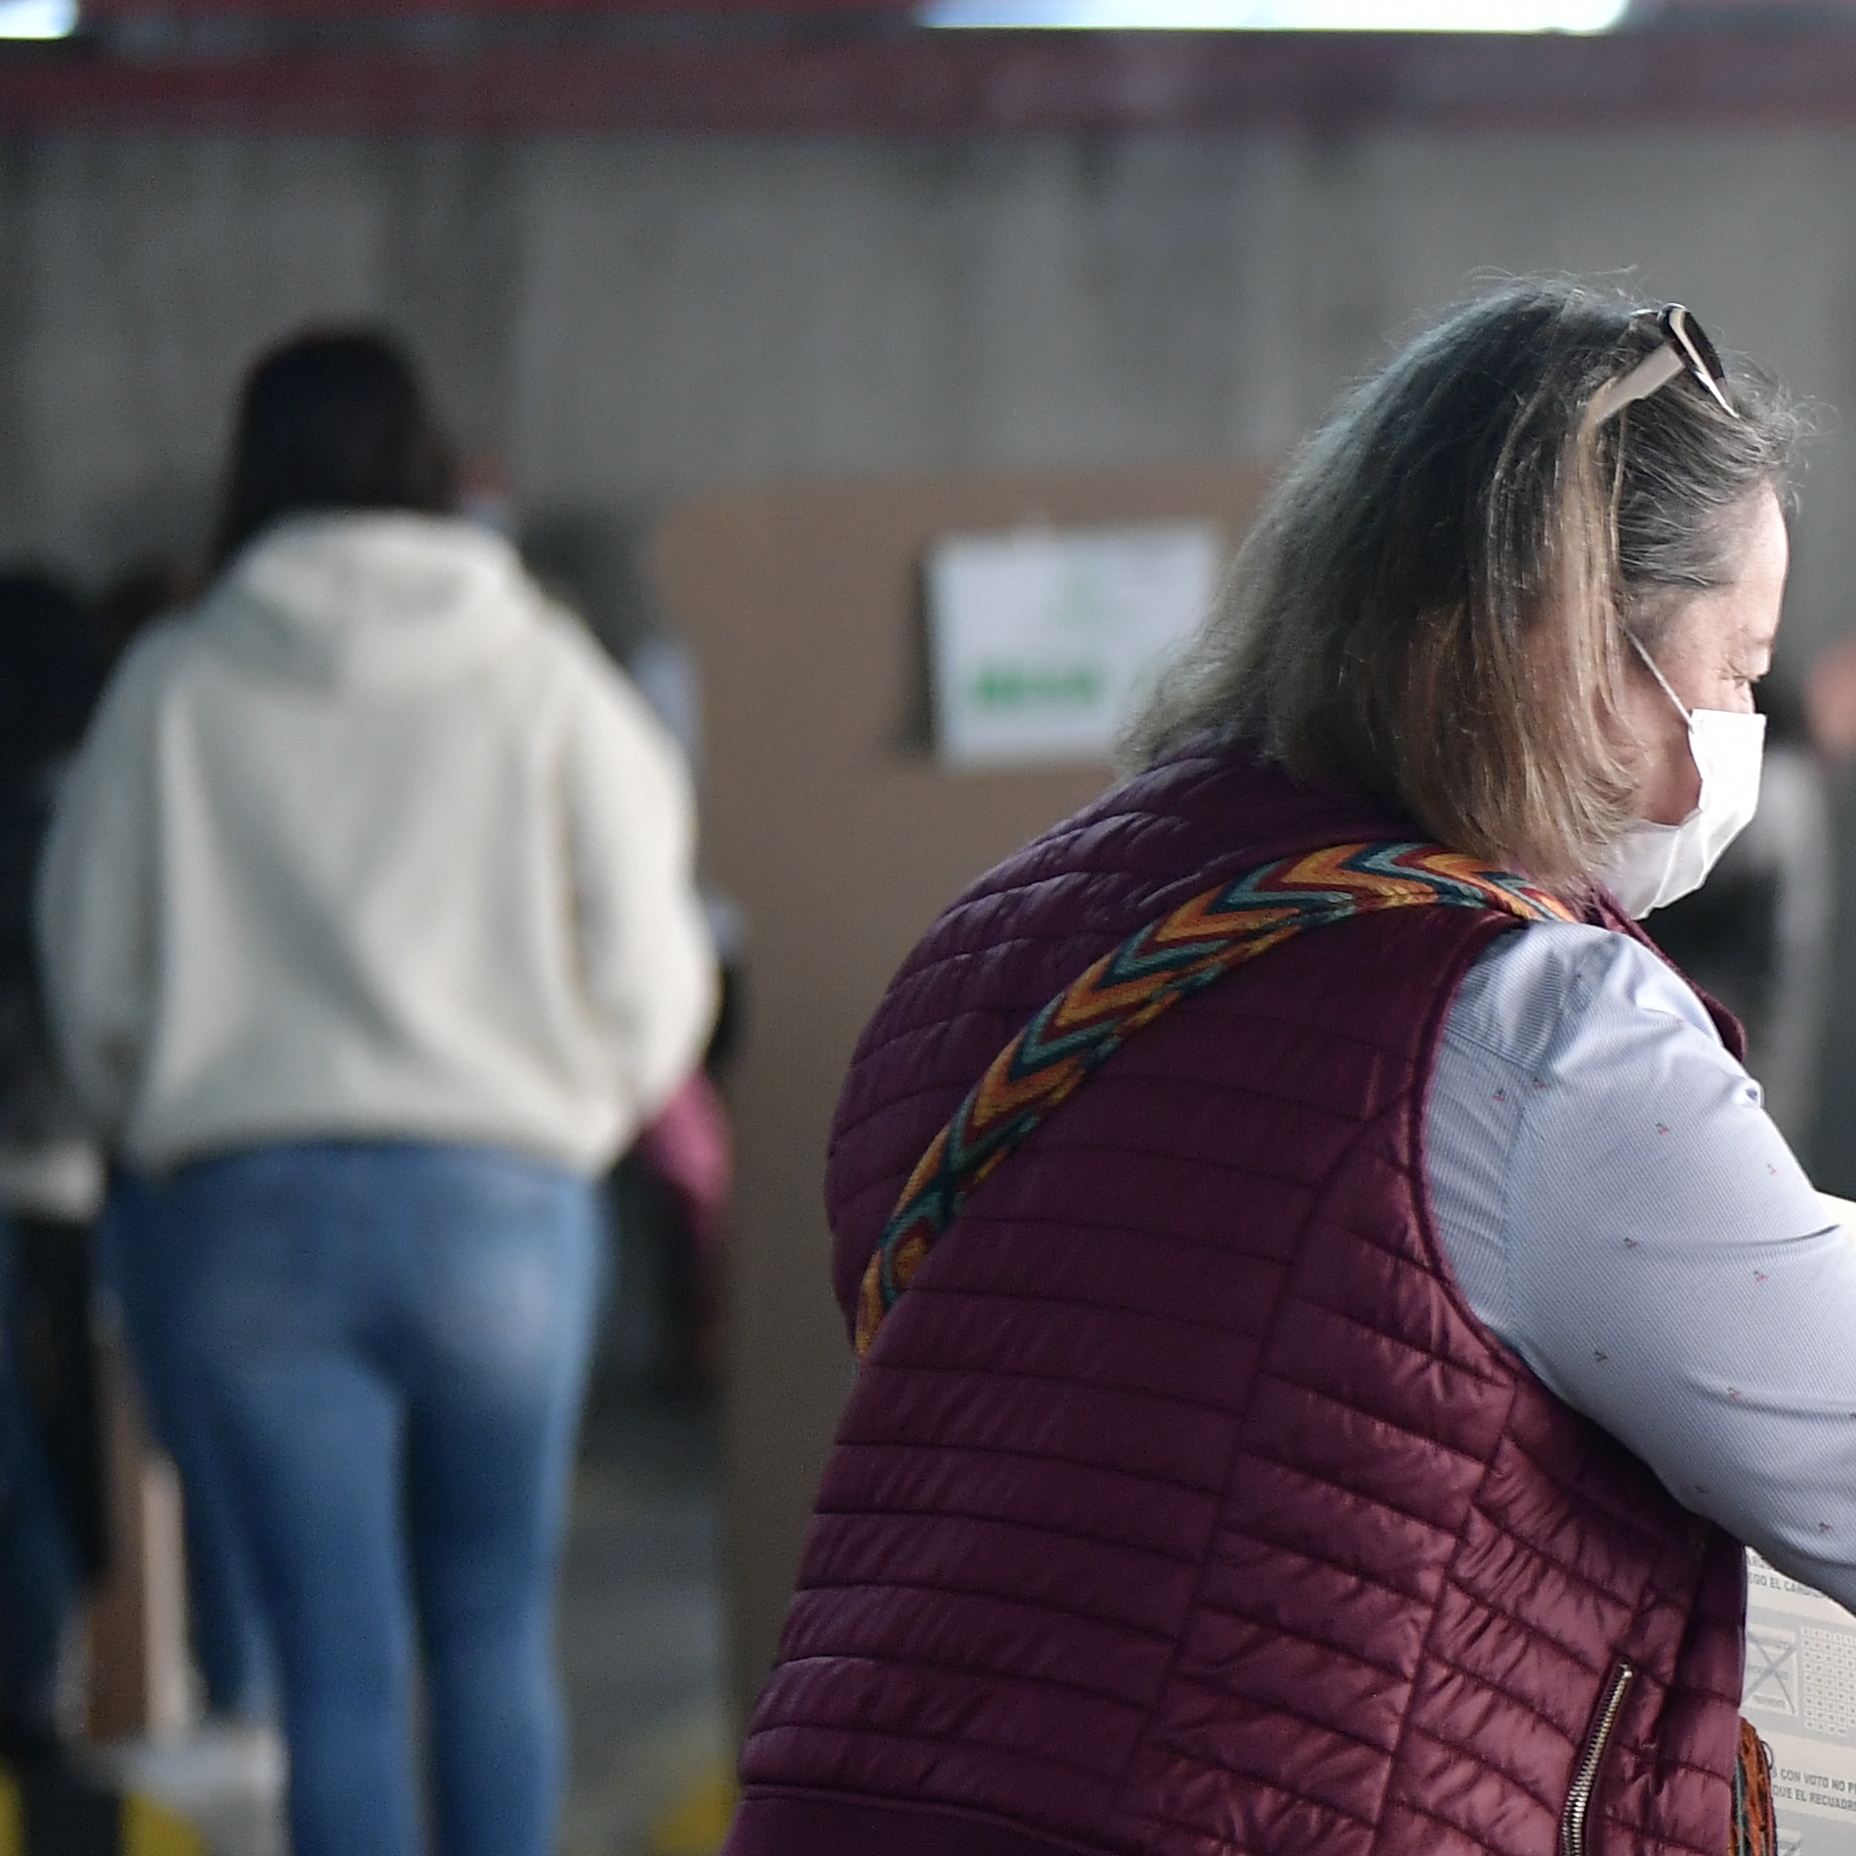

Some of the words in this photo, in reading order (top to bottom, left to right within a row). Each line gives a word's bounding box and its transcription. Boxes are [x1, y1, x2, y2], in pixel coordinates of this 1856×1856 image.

[1770, 1577, 1782, 1590] EL
[1780, 1769, 1801, 1782] CON
[1803, 1774, 1830, 1789] VOTO
[1831, 1779, 1846, 1792] NO
[1795, 1789, 1807, 1802] EL
